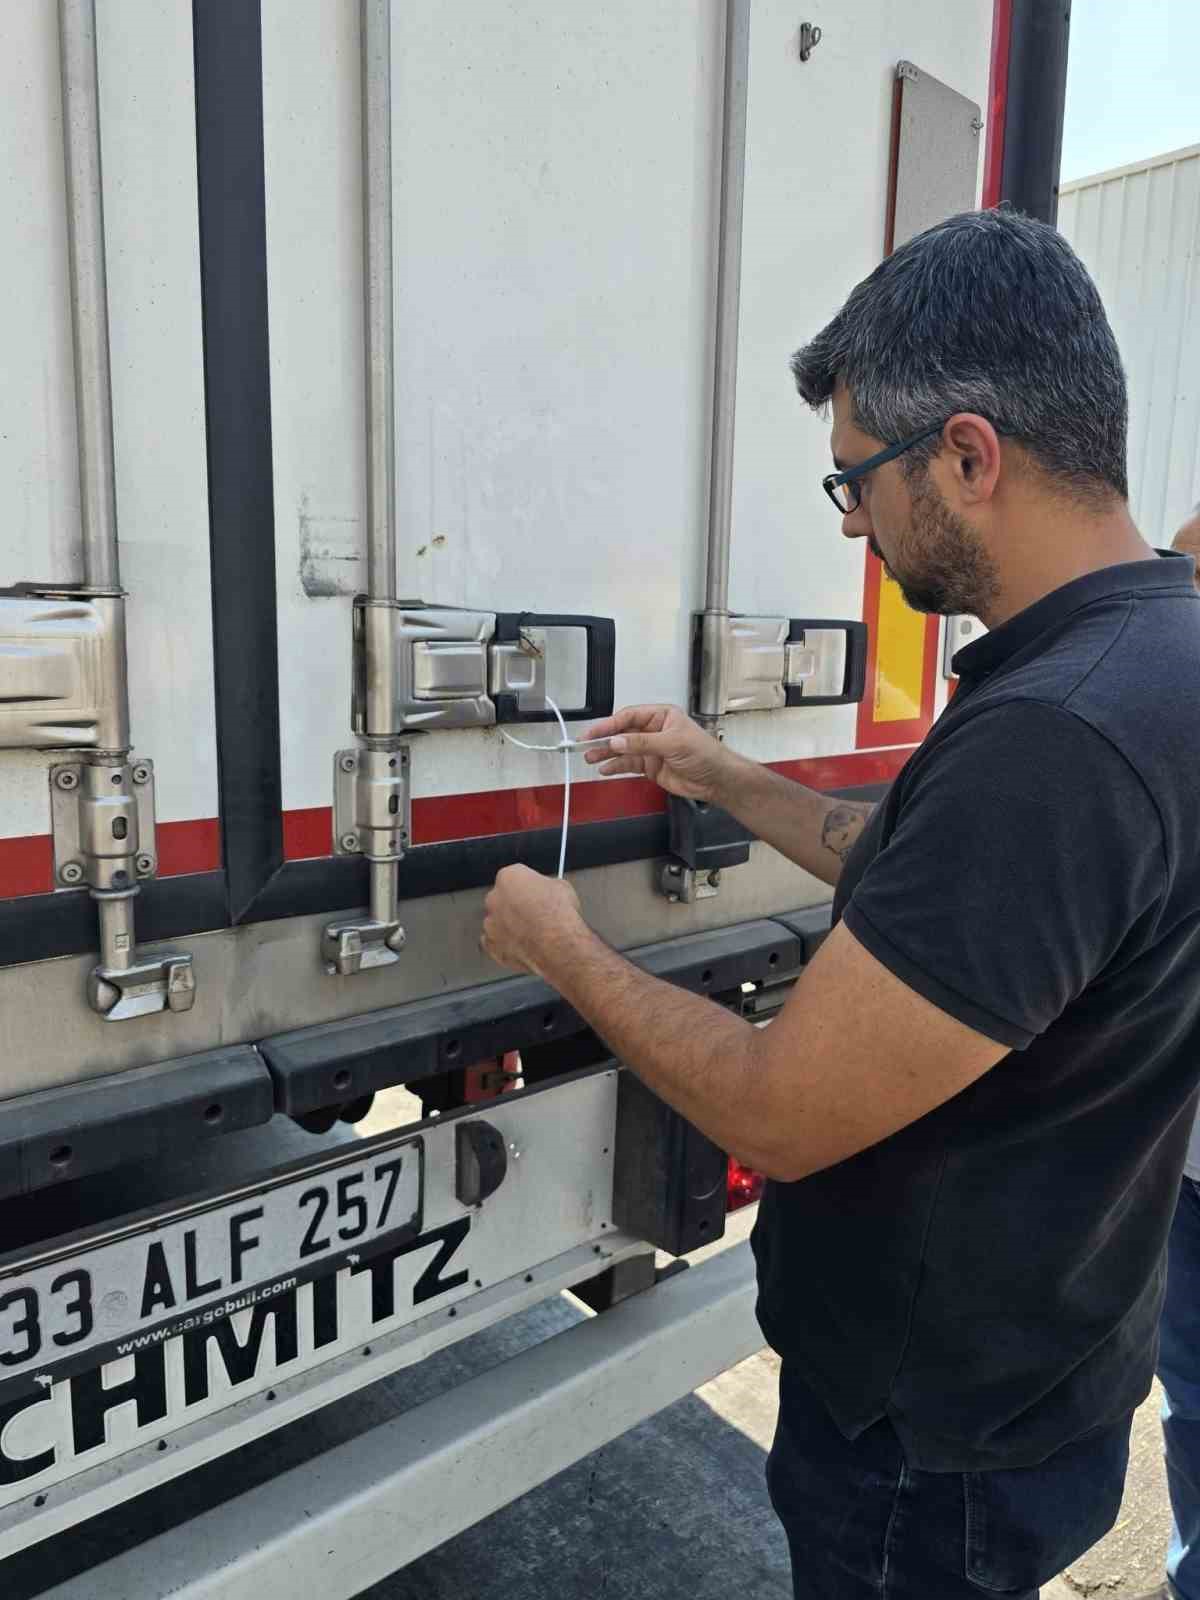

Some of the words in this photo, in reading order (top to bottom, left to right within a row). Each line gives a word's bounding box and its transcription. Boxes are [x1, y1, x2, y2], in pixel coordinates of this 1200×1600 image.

[0, 1269, 93, 1366] 33
[140, 1206, 263, 1319] ALF
[299, 1157, 402, 1258] 257
